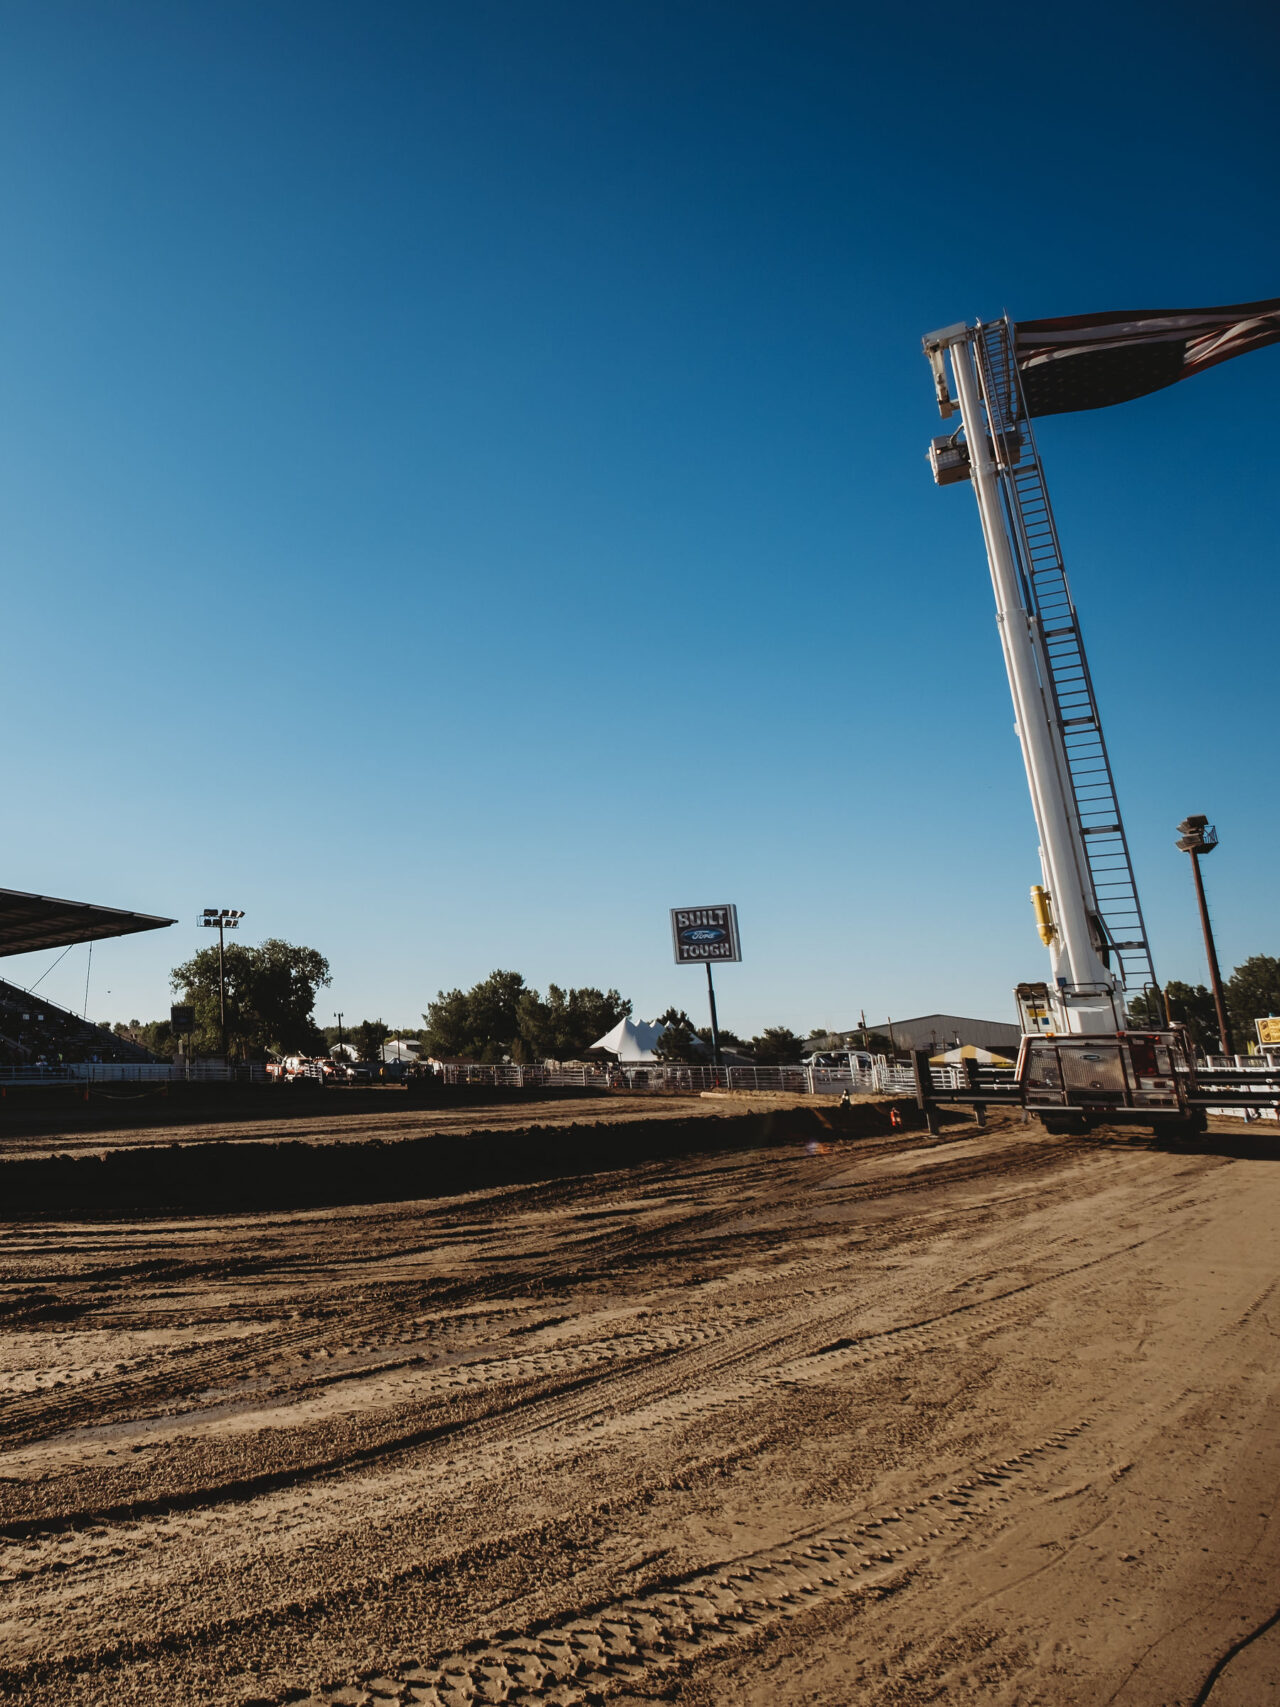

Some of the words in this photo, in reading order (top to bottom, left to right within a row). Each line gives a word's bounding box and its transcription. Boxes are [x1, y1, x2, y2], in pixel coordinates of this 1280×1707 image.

[677, 909, 726, 928] BUILT
[692, 930, 715, 940] Ford
[680, 943, 730, 958] TOUGH
